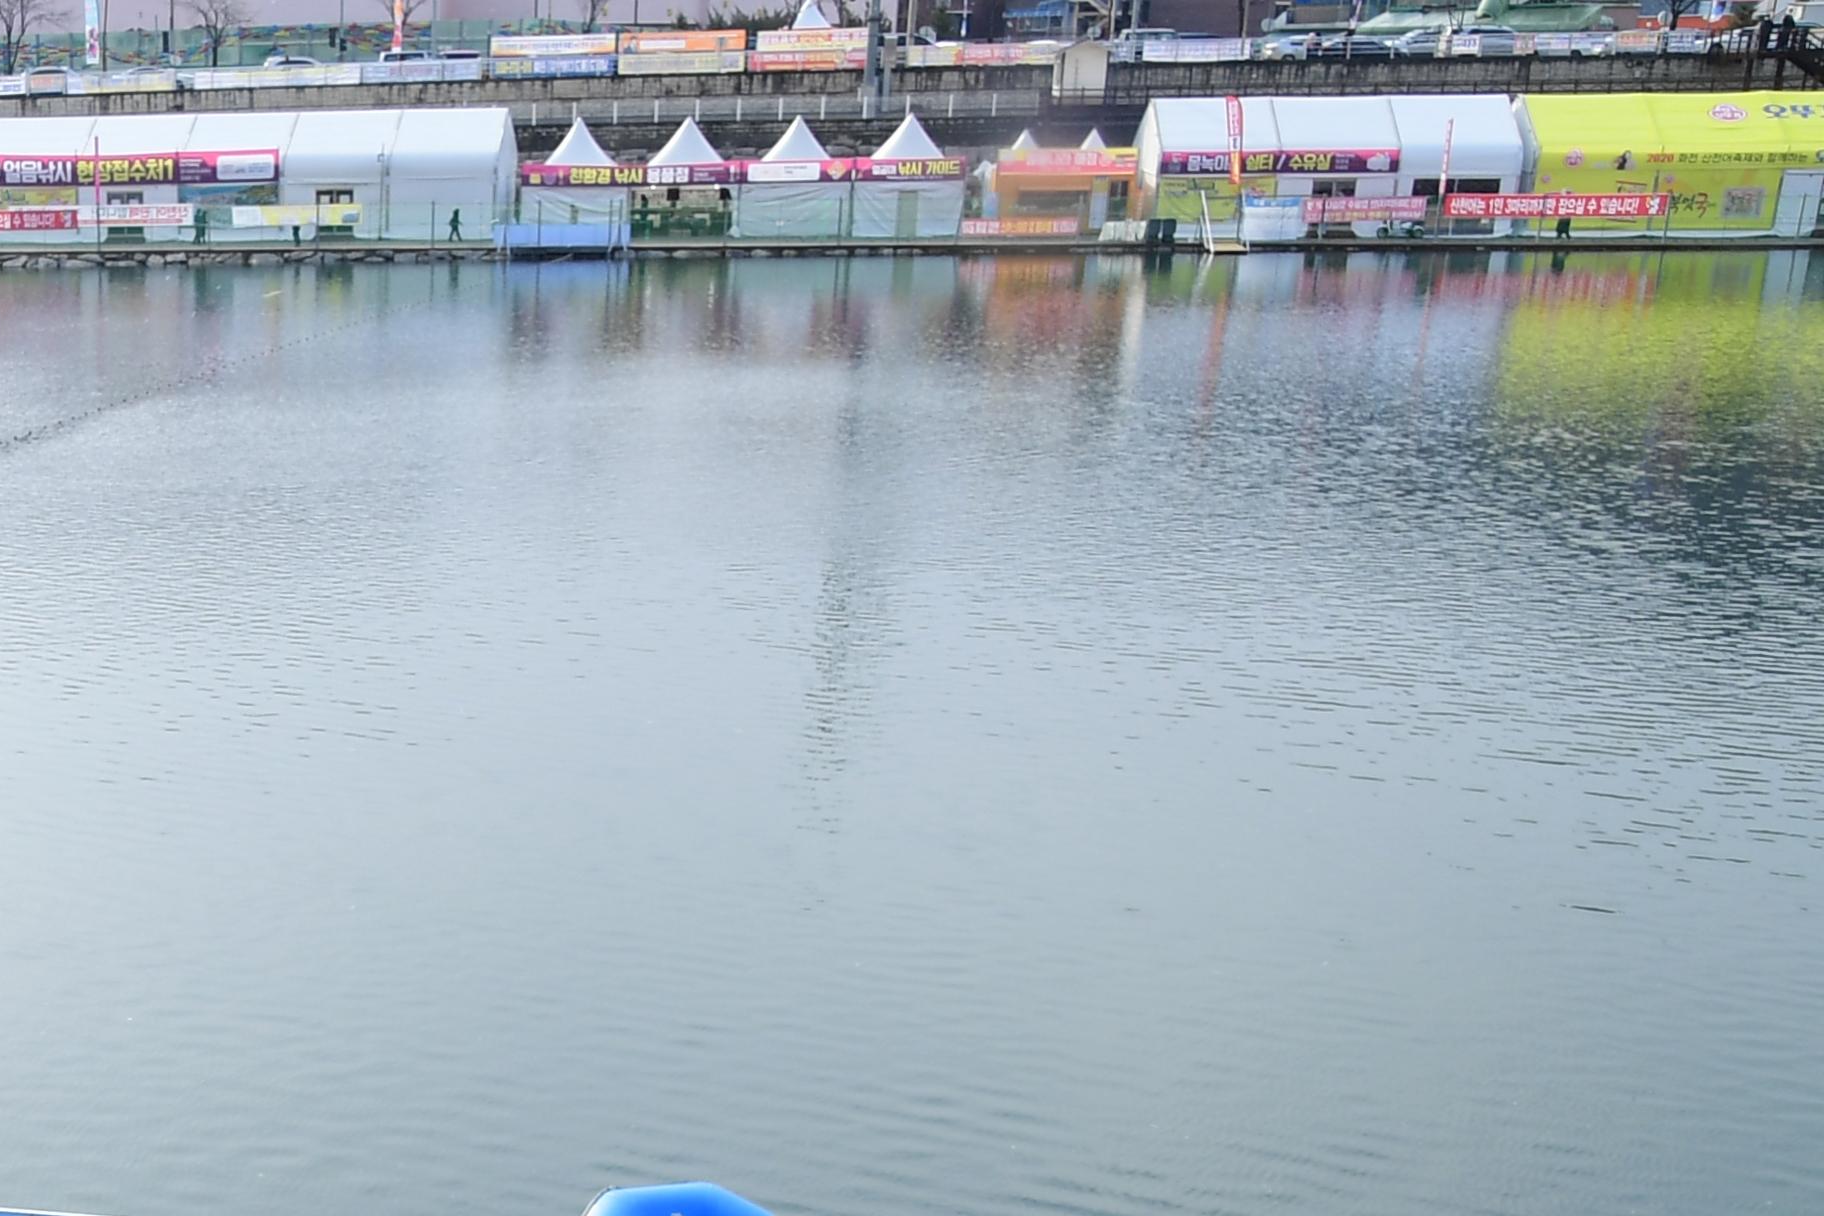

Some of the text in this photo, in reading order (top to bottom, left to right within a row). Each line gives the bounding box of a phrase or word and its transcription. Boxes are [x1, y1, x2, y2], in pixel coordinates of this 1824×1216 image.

[1647, 153, 1675, 163] 2020
[2, 161, 72, 184] 얼음낚시
[1450, 198, 1486, 215] 산천어는
[1488, 198, 1504, 213] 1인
[1558, 197, 1585, 214] 잡으실
[1587, 198, 1597, 213] 수
